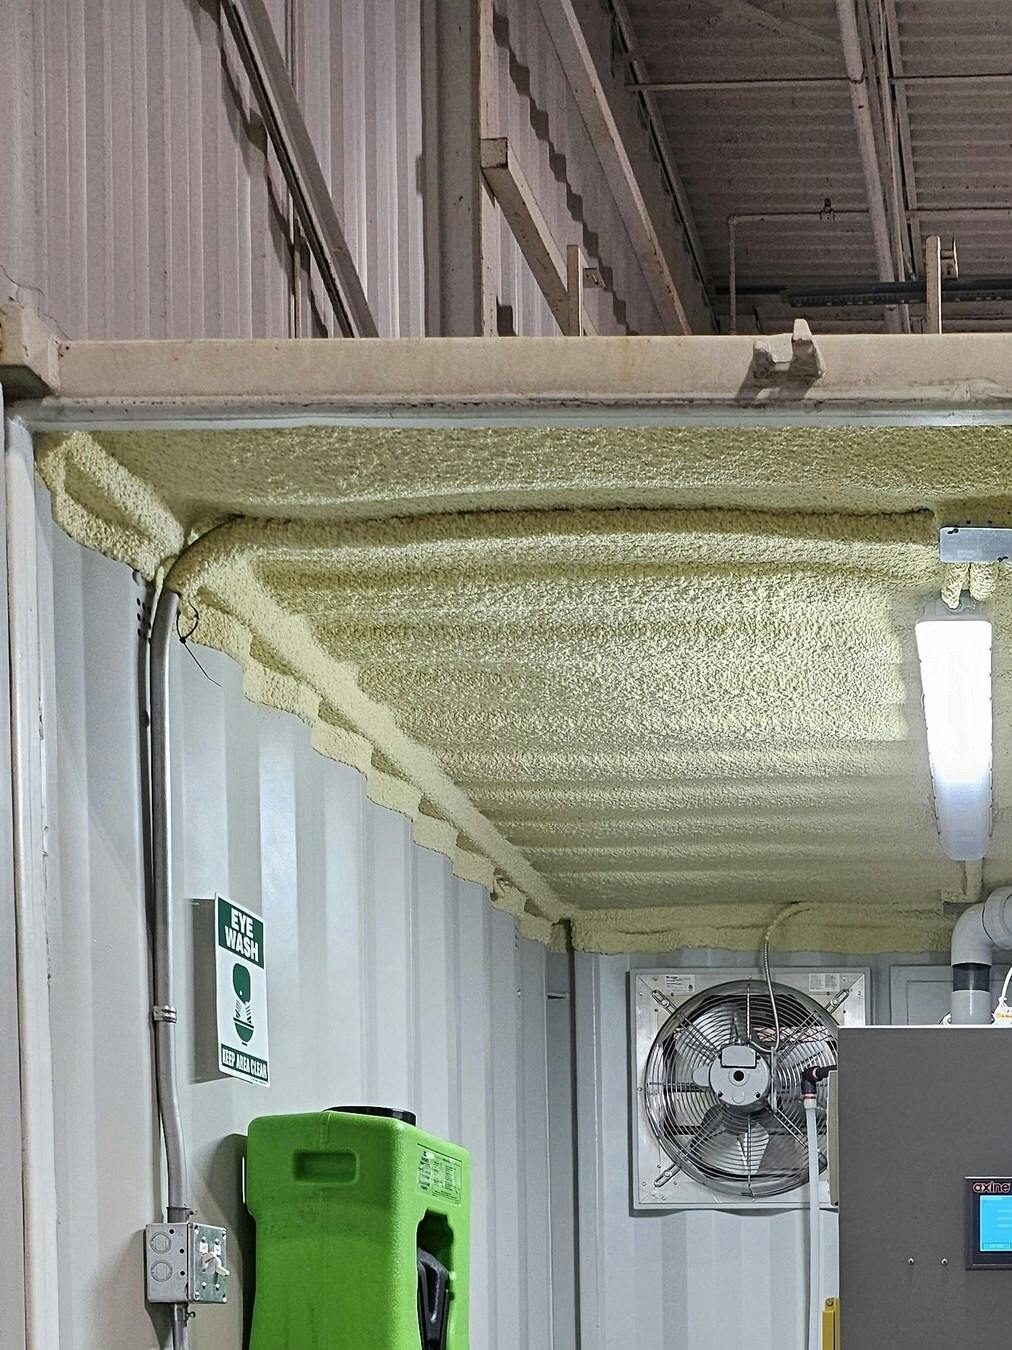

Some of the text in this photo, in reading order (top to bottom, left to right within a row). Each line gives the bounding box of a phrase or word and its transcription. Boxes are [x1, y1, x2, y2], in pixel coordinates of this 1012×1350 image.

[231, 907, 254, 939] EYE
[224, 925, 259, 963] WASH
[222, 1048, 267, 1079] KEEP AREA CLEAR
[973, 1181, 1010, 1193] axine
